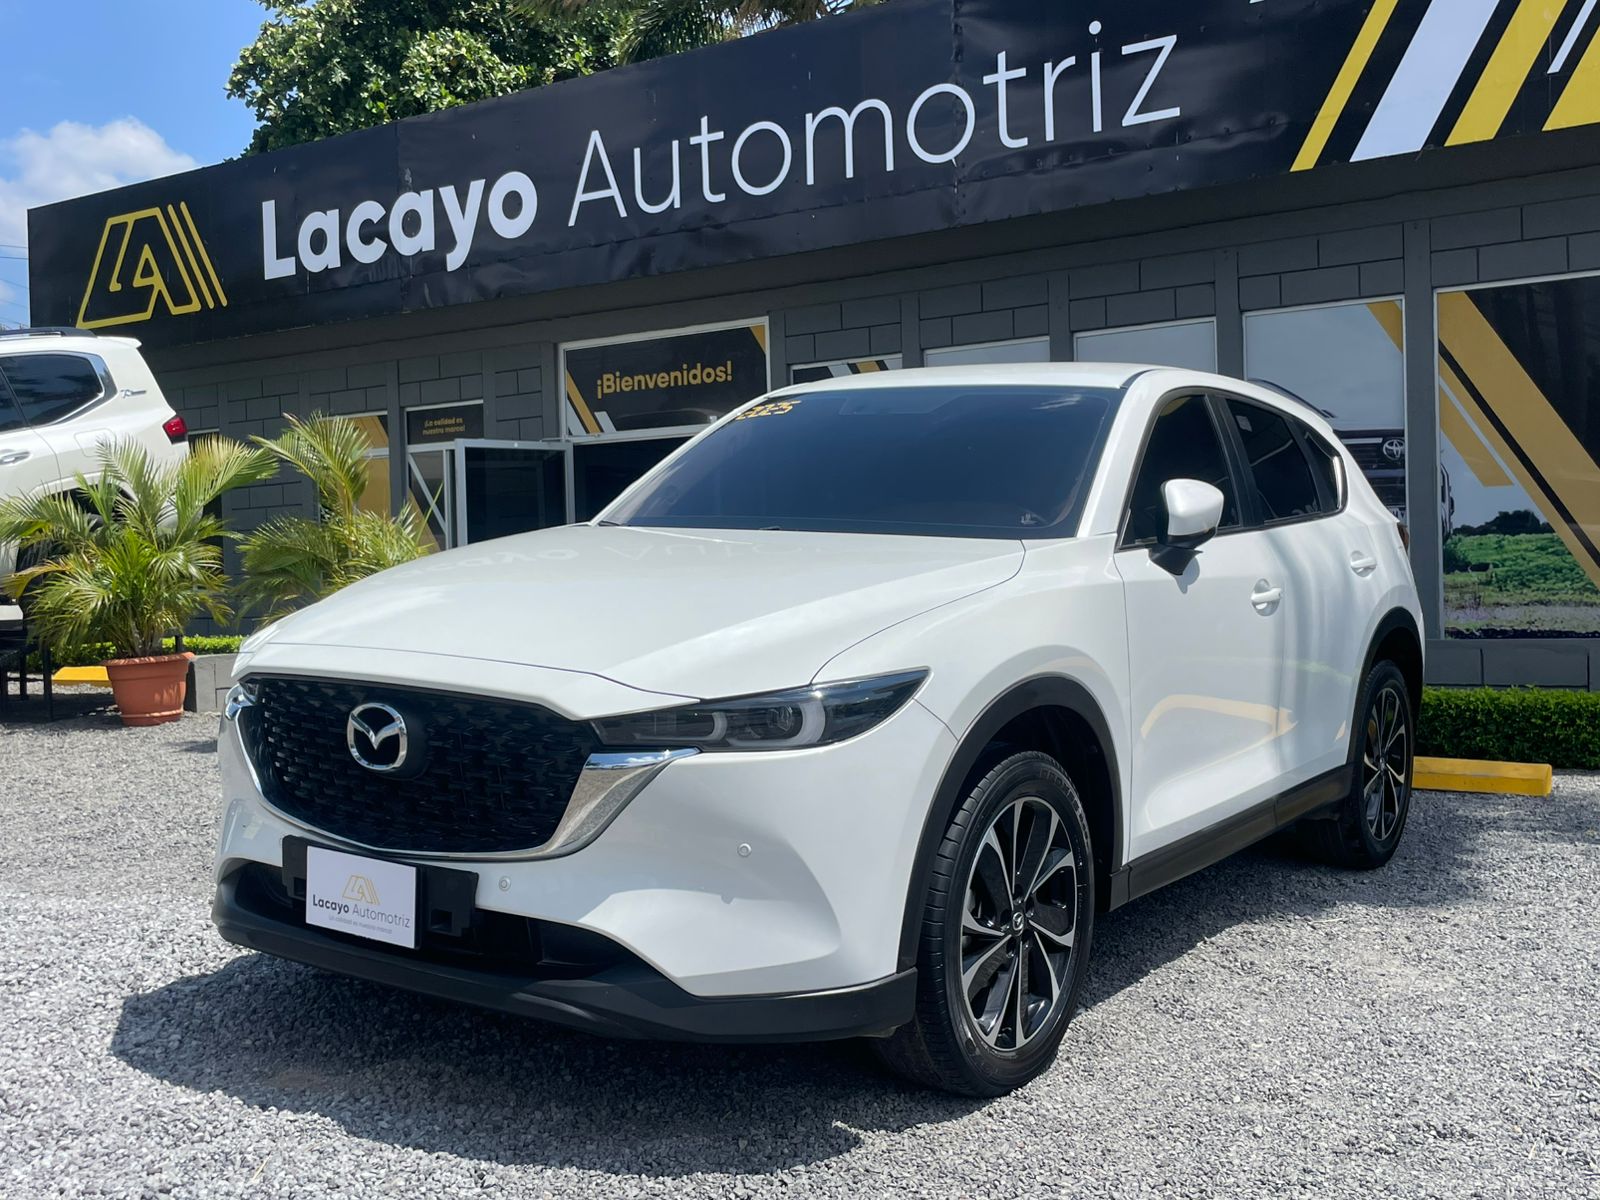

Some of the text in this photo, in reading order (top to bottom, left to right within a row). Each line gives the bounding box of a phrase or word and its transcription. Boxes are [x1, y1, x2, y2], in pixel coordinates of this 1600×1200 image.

[262, 20, 1182, 281] Lacayo Automotriz
[596, 361, 733, 400] ¡Bienvenidos!
[312, 894, 350, 915] Lacayo
[352, 903, 411, 929] Automotriz
